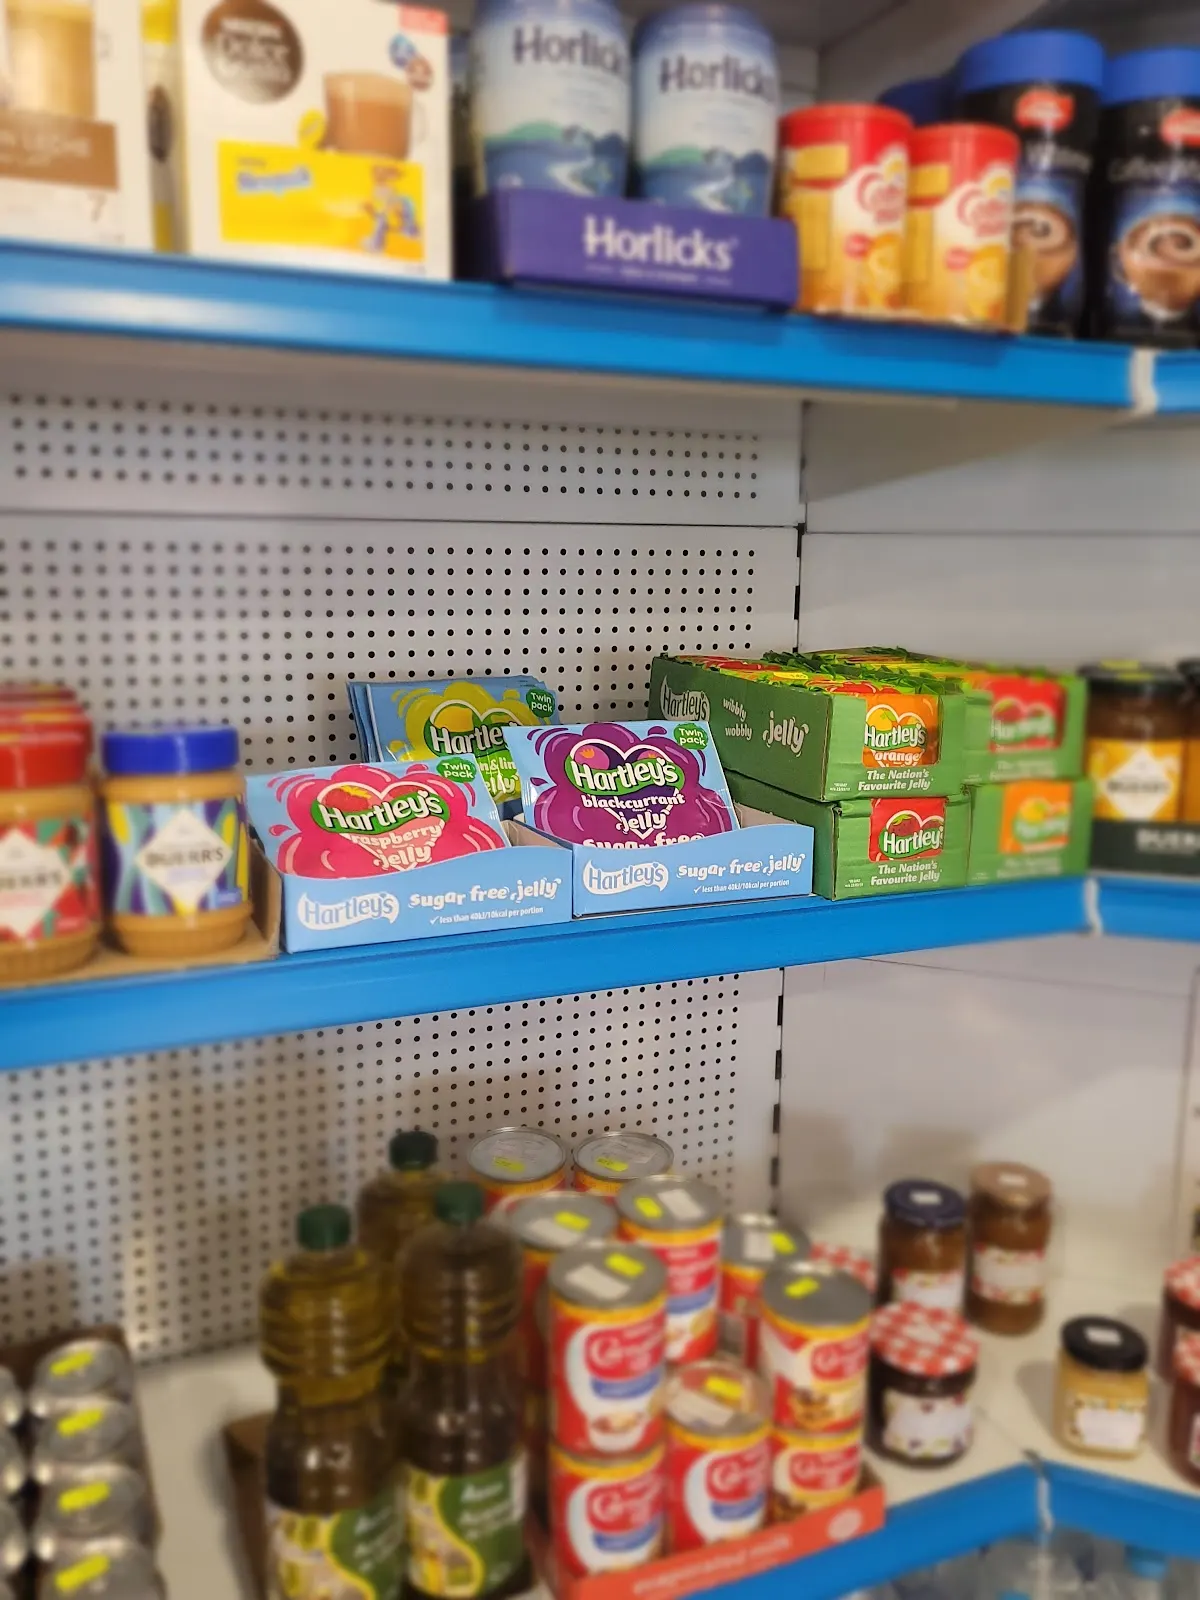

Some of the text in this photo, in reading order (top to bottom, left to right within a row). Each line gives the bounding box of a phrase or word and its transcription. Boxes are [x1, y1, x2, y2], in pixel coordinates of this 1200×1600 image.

[583, 213, 734, 272] Horlicks
[530, 691, 552, 703] Twin
[531, 701, 553, 713] pack
[661, 682, 708, 721] Hartley's
[722, 696, 747, 723] wibbly
[430, 725, 504, 754] Hartle
[678, 727, 703, 739] Twin
[679, 736, 706, 748] pack
[724, 722, 753, 741] wobbly
[763, 709, 809, 758] jelly
[864, 722, 926, 748] Hartley's
[442, 761, 471, 772] Twin
[874, 751, 921, 765] orange
[443, 769, 474, 780] pack
[570, 758, 679, 792] Hartley's
[858, 780, 906, 791] Favourite
[907, 779, 931, 791] Jelly
[867, 769, 929, 780] The Nation's
[318, 790, 444, 831] Hartley's
[581, 793, 686, 810] blackcurrant
[616, 808, 671, 835] jelly
[351, 824, 442, 849] raspberry
[883, 826, 944, 854] Hartley'
[373, 842, 436, 870] jelly
[678, 853, 806, 880] sugar free jelly
[878, 860, 938, 875] The Nation's
[587, 860, 665, 891] Hartley's
[702, 884, 713, 893] less
[713, 884, 727, 893] than
[759, 880, 769, 890] per
[769, 878, 790, 888] portion
[871, 873, 917, 886] Favourite
[918, 870, 941, 883] Jelly
[409, 877, 562, 910] sugar free jelly
[304, 890, 395, 926] Hartley's
[439, 916, 453, 925] less
[453, 914, 470, 924] than
[508, 908, 520, 918] per
[520, 905, 544, 915] portion
